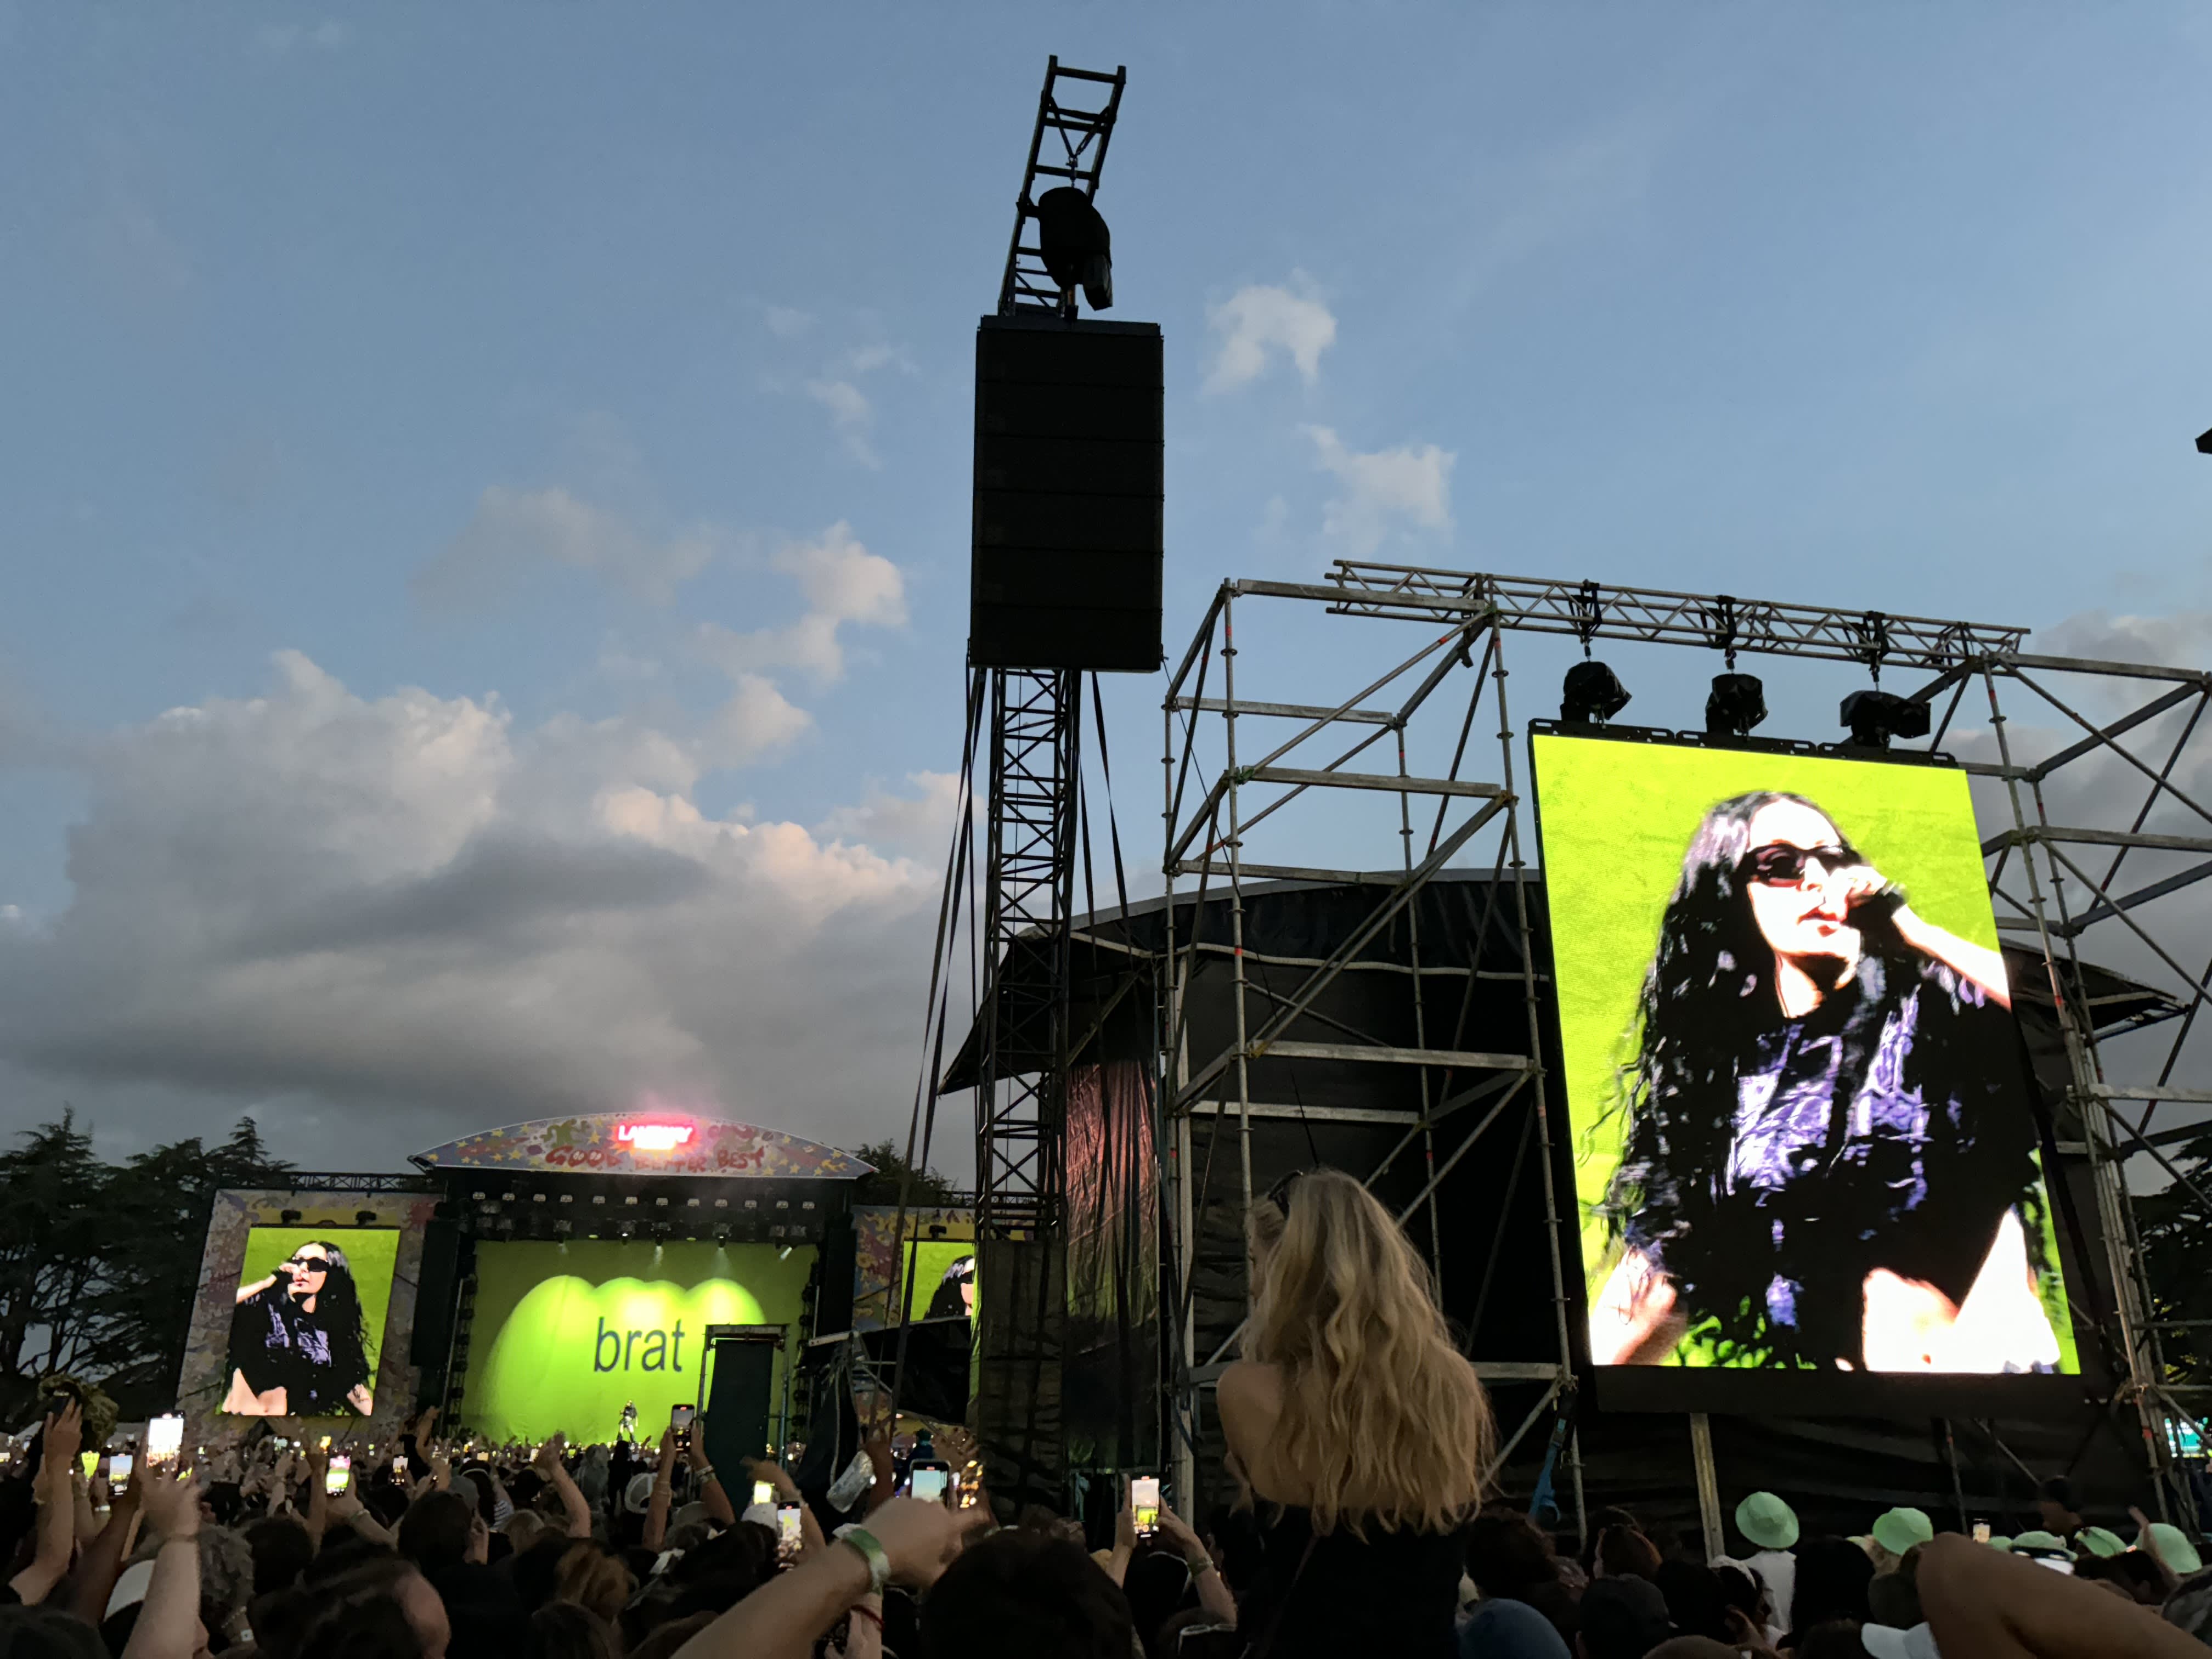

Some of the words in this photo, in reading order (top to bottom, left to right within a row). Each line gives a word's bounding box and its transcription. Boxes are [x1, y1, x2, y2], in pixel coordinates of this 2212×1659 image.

[545, 1145, 621, 1168] GOOD
[716, 1146, 764, 1169] BEST
[594, 1316, 685, 1372] brat
